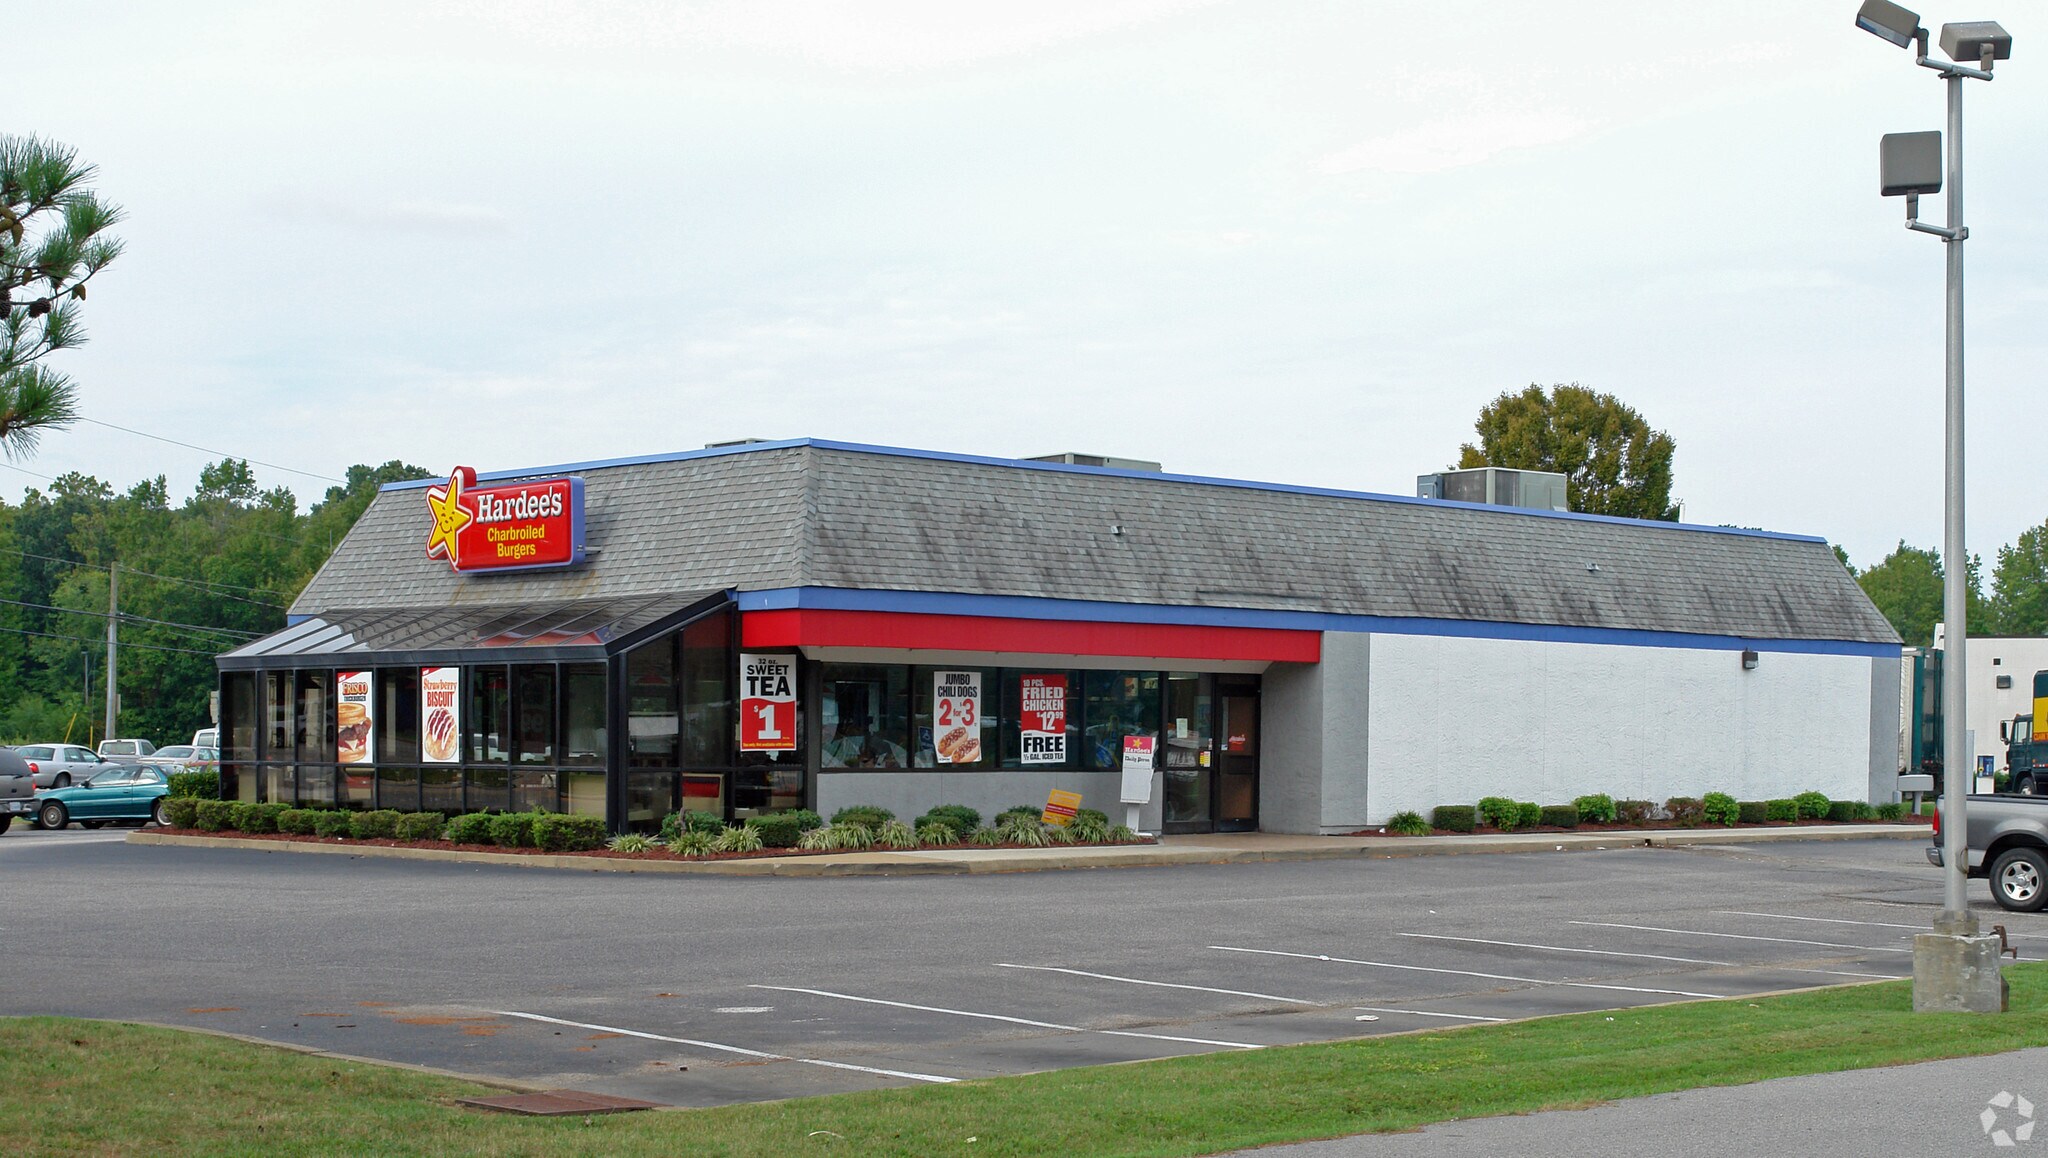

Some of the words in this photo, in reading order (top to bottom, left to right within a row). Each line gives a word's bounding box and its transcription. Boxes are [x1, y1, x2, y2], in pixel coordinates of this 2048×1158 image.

[476, 486, 563, 523] Hardee's
[487, 524, 545, 542] Charbroiled
[497, 543, 536, 559] Burgers
[747, 665, 789, 675] SWEET
[423, 678, 457, 692] Strawberry
[746, 676, 791, 696] TEA
[945, 673, 970, 685] JUMBO
[342, 682, 368, 696] FRISCO
[938, 686, 956, 698] CHILI
[957, 686, 977, 698] DOGS
[1023, 687, 1064, 700] FRIED
[427, 691, 453, 707] BISCUIT
[1023, 699, 1064, 712] CHICKEN
[939, 698, 952, 726] 2
[953, 708, 962, 717] for
[1023, 736, 1063, 753] FREE
